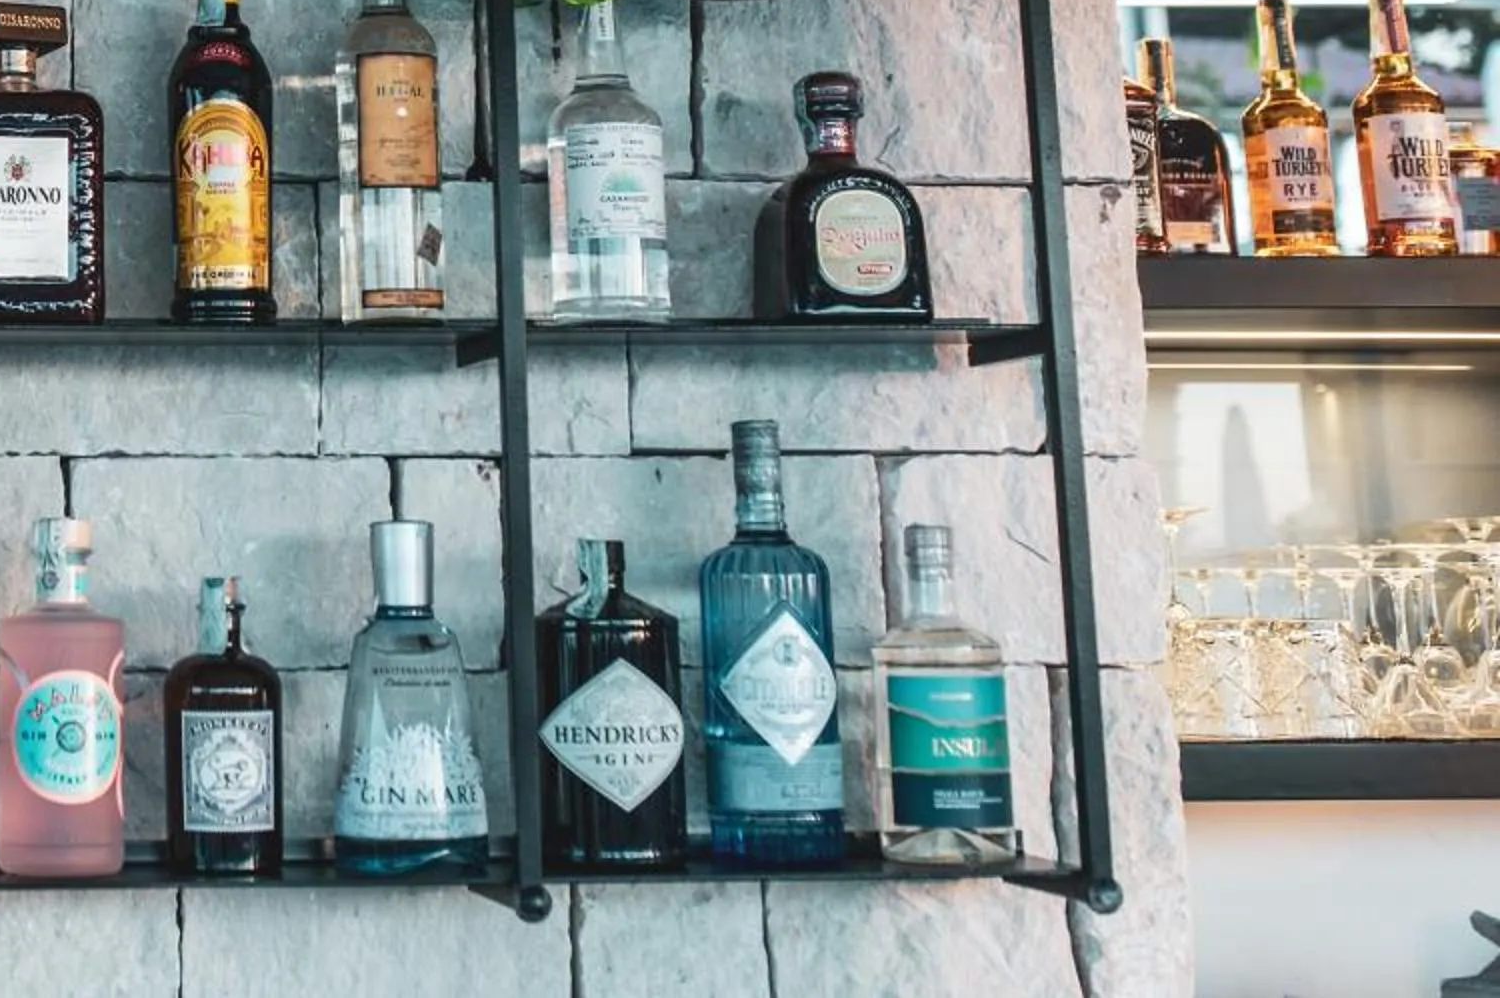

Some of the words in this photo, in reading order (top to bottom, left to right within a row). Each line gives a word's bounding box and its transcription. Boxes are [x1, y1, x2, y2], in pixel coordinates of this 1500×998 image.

[0, 13, 62, 29] DISARONNO
[1281, 146, 1317, 161] WILD
[1272, 159, 1323, 177] TURKEY
[1283, 183, 1318, 197] RYE
[360, 786, 406, 805] GIN
